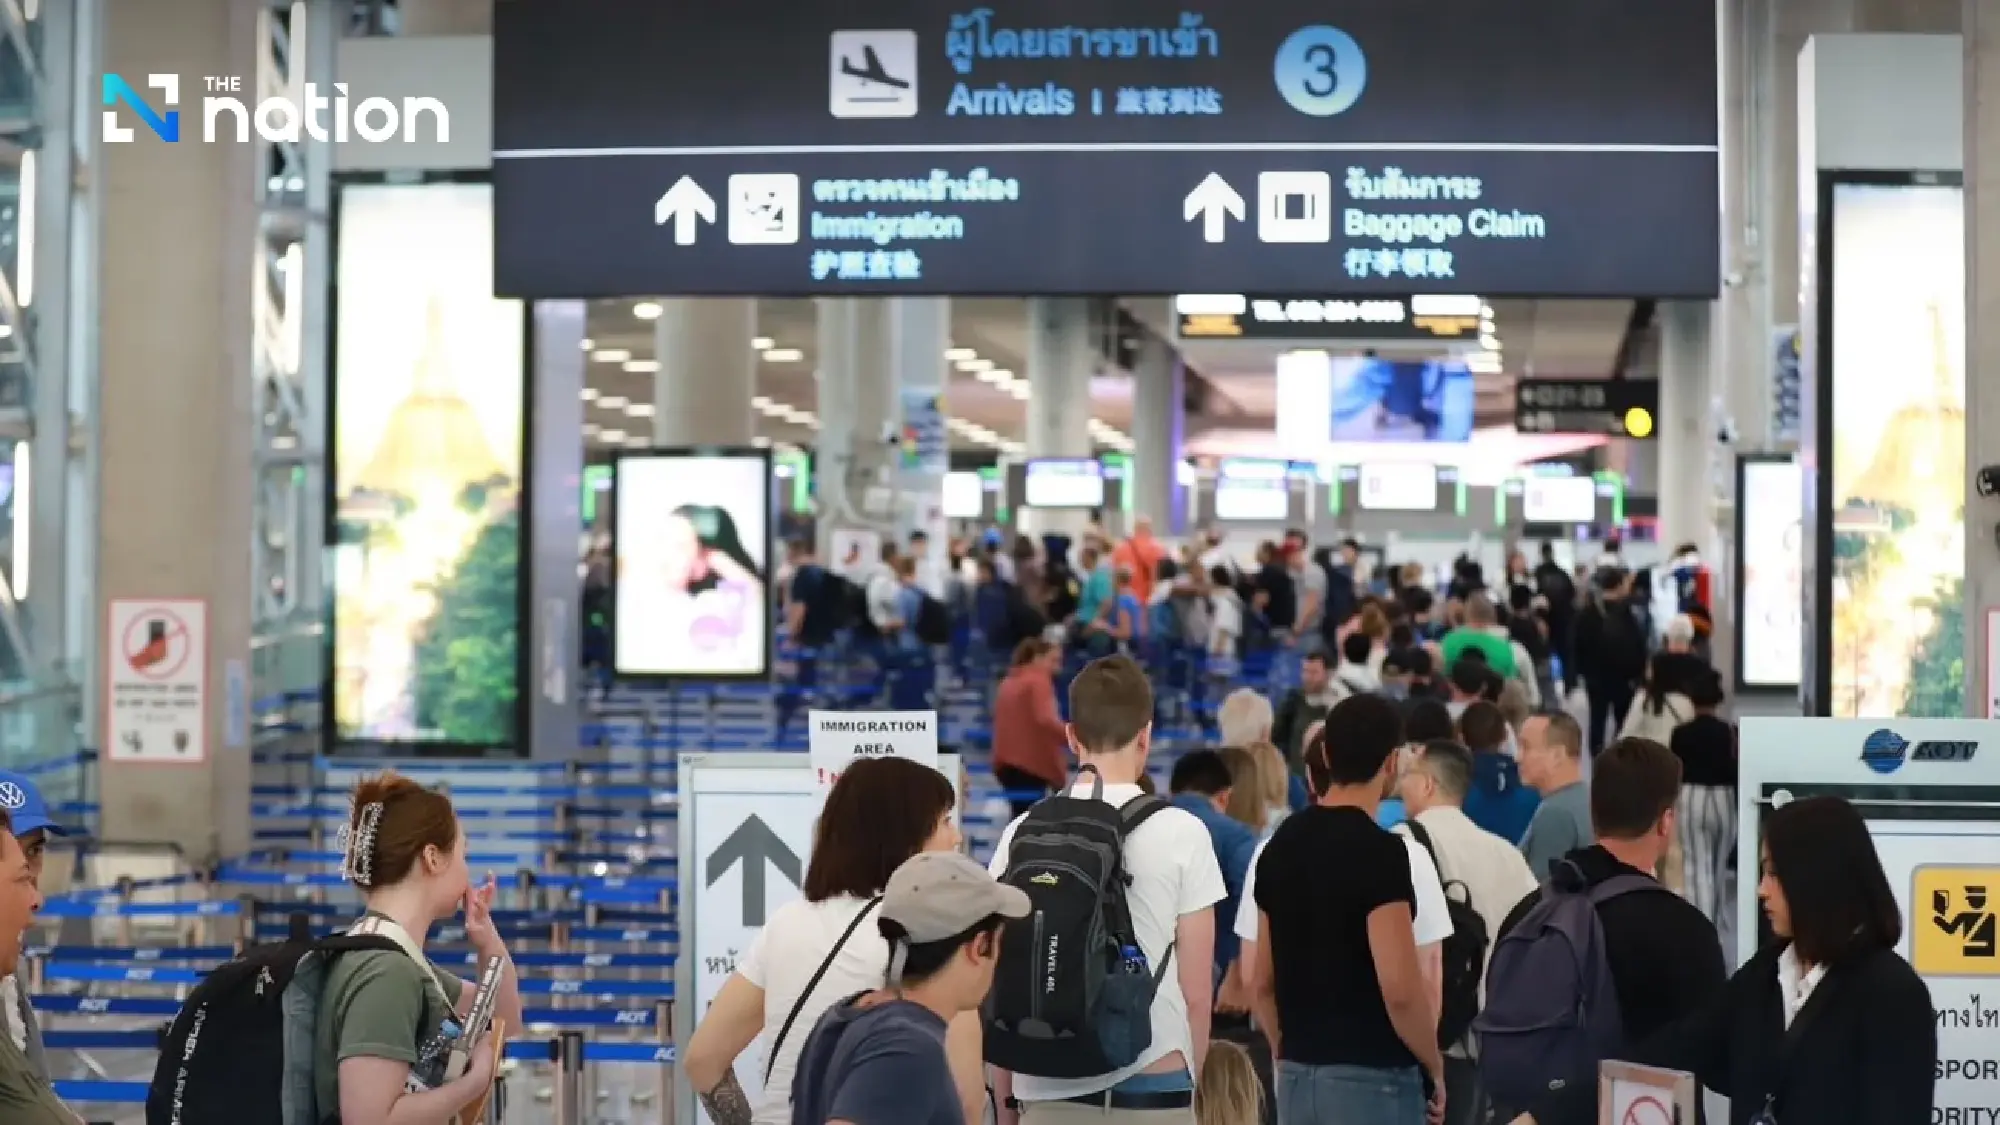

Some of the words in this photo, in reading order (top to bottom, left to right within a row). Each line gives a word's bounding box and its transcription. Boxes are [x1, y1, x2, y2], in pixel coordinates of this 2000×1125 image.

[1302, 44, 1338, 98] 3
[946, 82, 1075, 116] Arrivals
[811, 211, 963, 245] Immigration
[1345, 208, 1463, 243] Baggage
[1467, 208, 1546, 237] Claim
[820, 721, 927, 732] IMMIGRATION
[853, 743, 895, 754] AREA
[1047, 934, 1059, 975] TRAVEL
